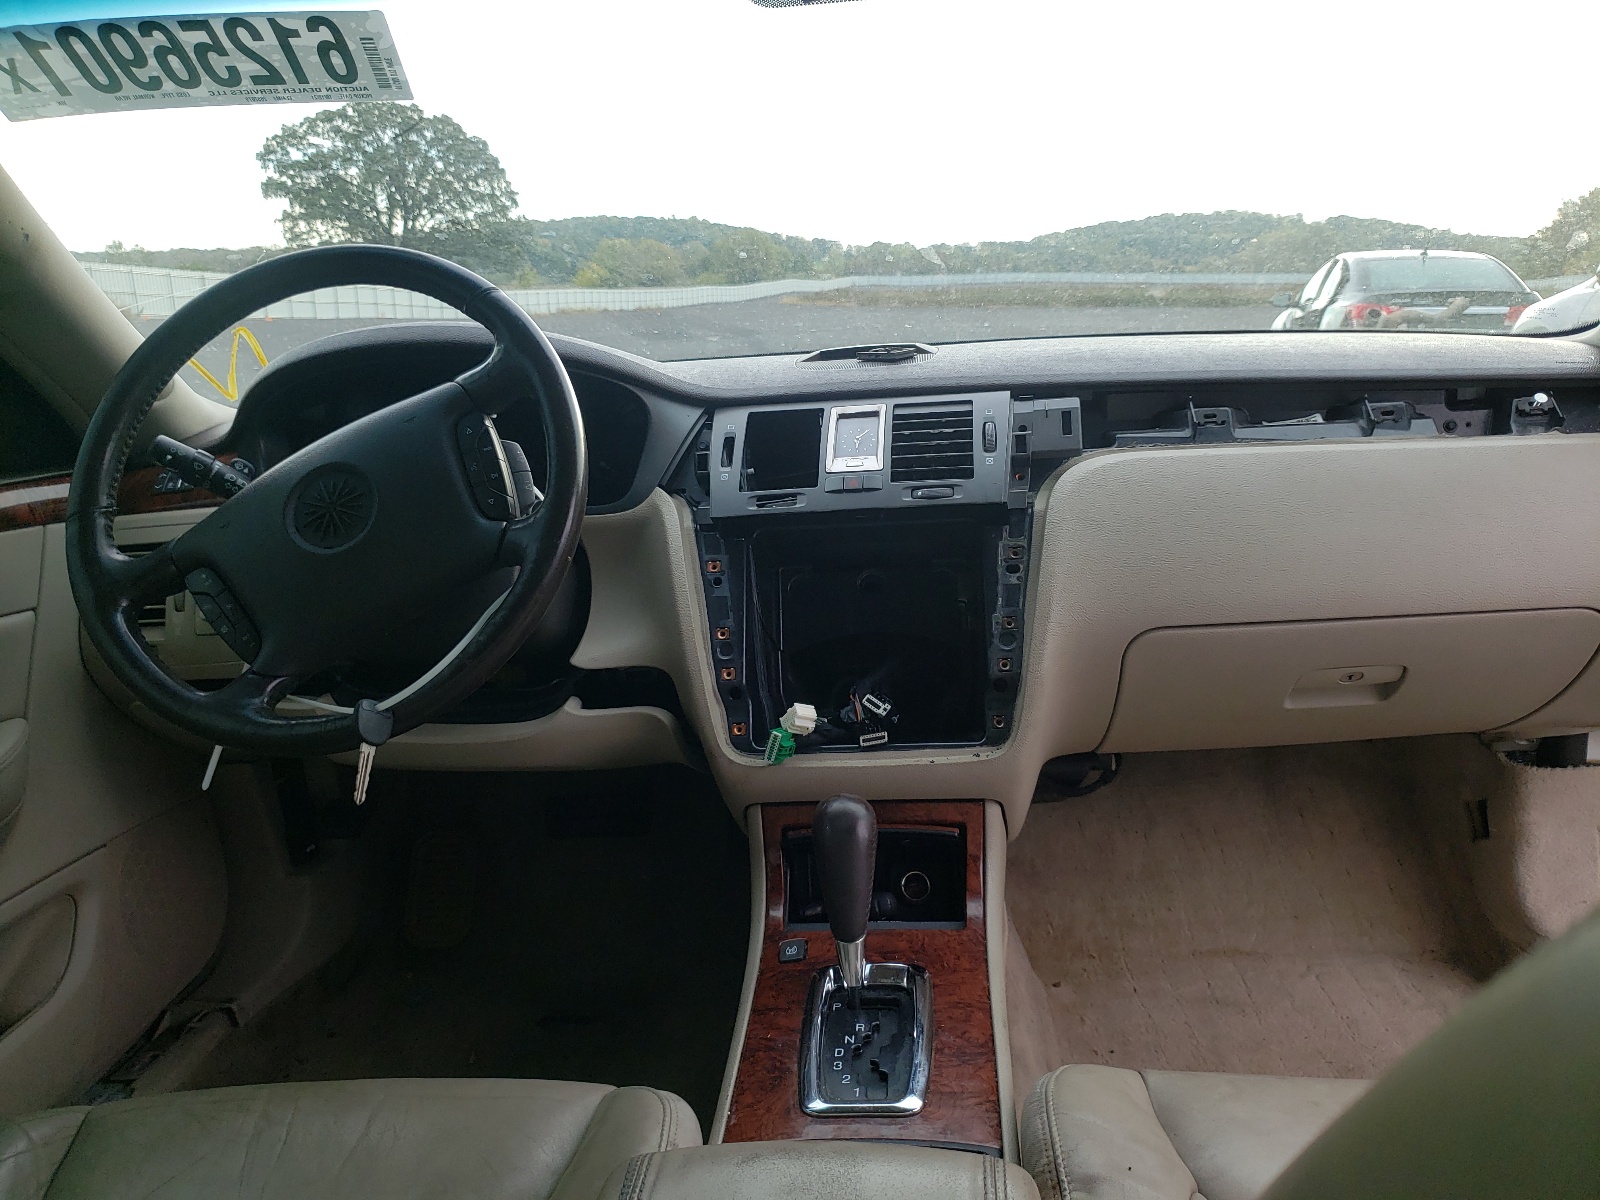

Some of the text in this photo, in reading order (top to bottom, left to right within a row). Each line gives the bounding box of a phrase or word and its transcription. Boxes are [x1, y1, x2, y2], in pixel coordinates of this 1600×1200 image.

[832, 1003, 842, 1011] P
[855, 1023, 865, 1031] R
[844, 1035, 855, 1044] N
[834, 1048, 844, 1057] D
[833, 1061, 843, 1070] 3
[841, 1075, 851, 1084] 2
[853, 1087, 860, 1097] 1
